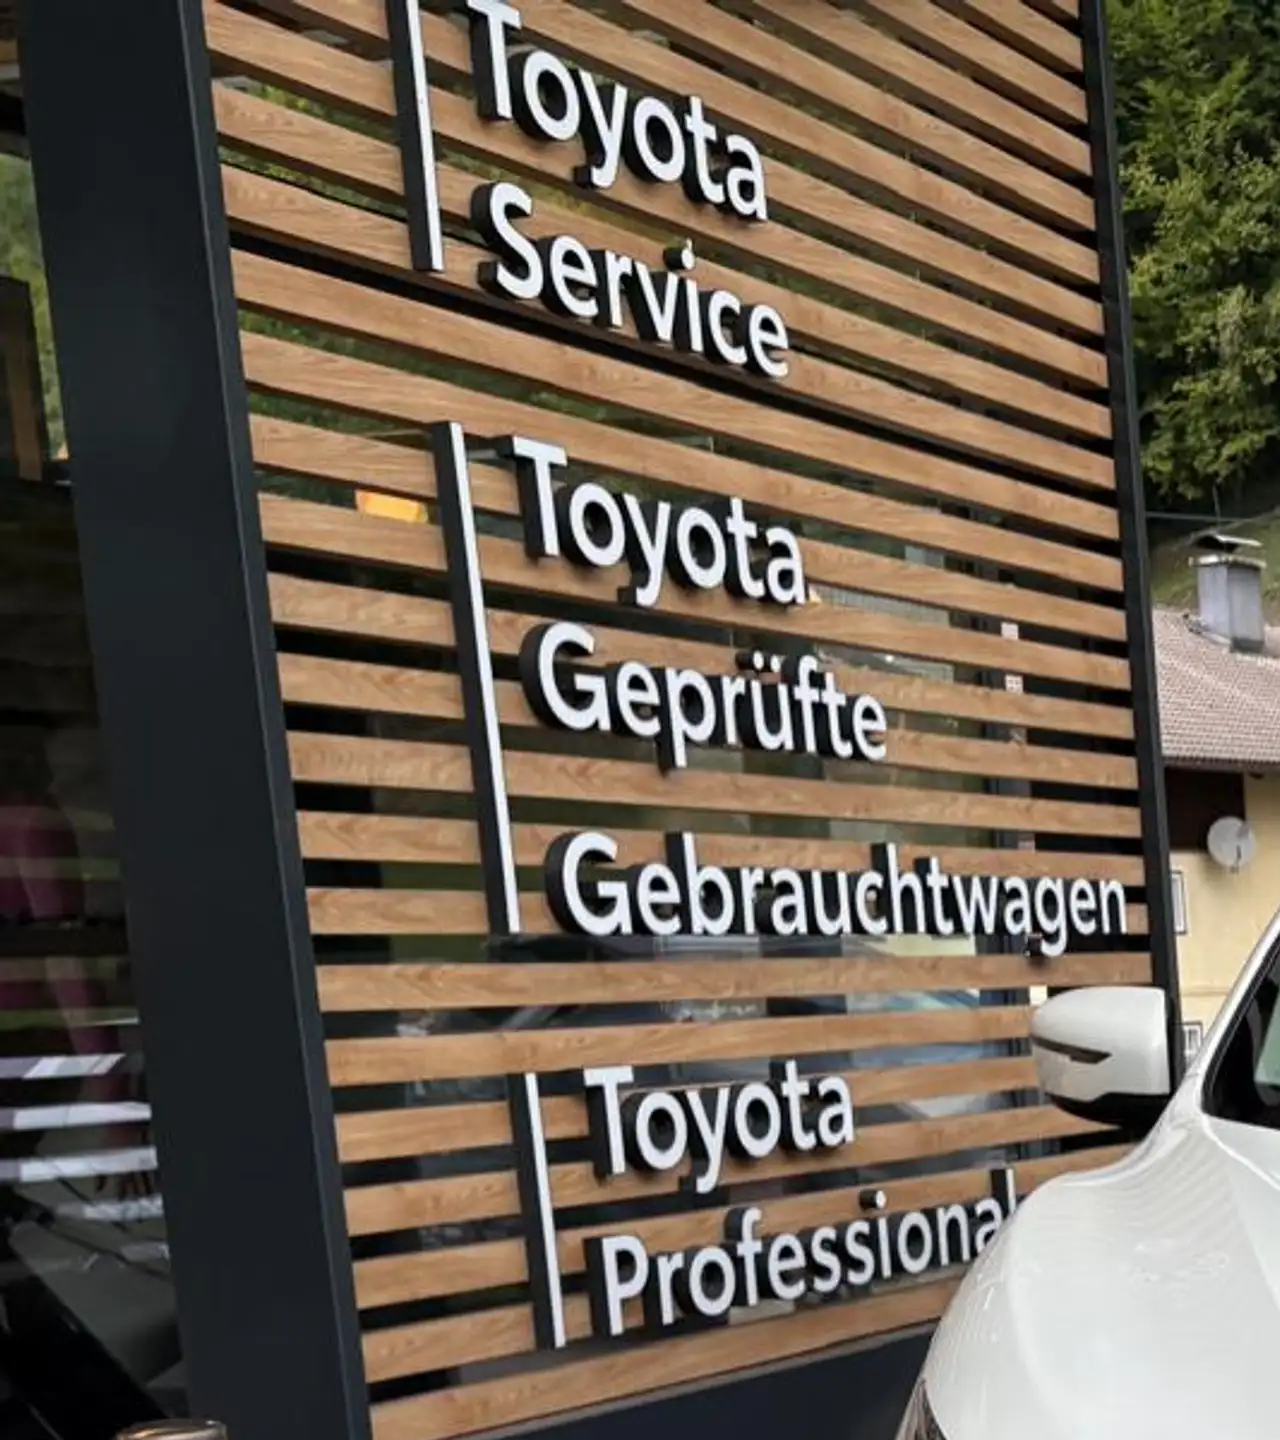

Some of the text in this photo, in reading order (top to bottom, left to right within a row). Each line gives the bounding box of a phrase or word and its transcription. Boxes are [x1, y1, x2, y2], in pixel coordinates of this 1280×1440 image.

[468, 0, 768, 221] Toyota
[491, 183, 790, 378] Service
[511, 435, 807, 606] Toyota
[538, 623, 889, 768] Geprüfte
[563, 831, 1128, 957] Gebrauchtwagen
[583, 1060, 855, 1193] Toyota
